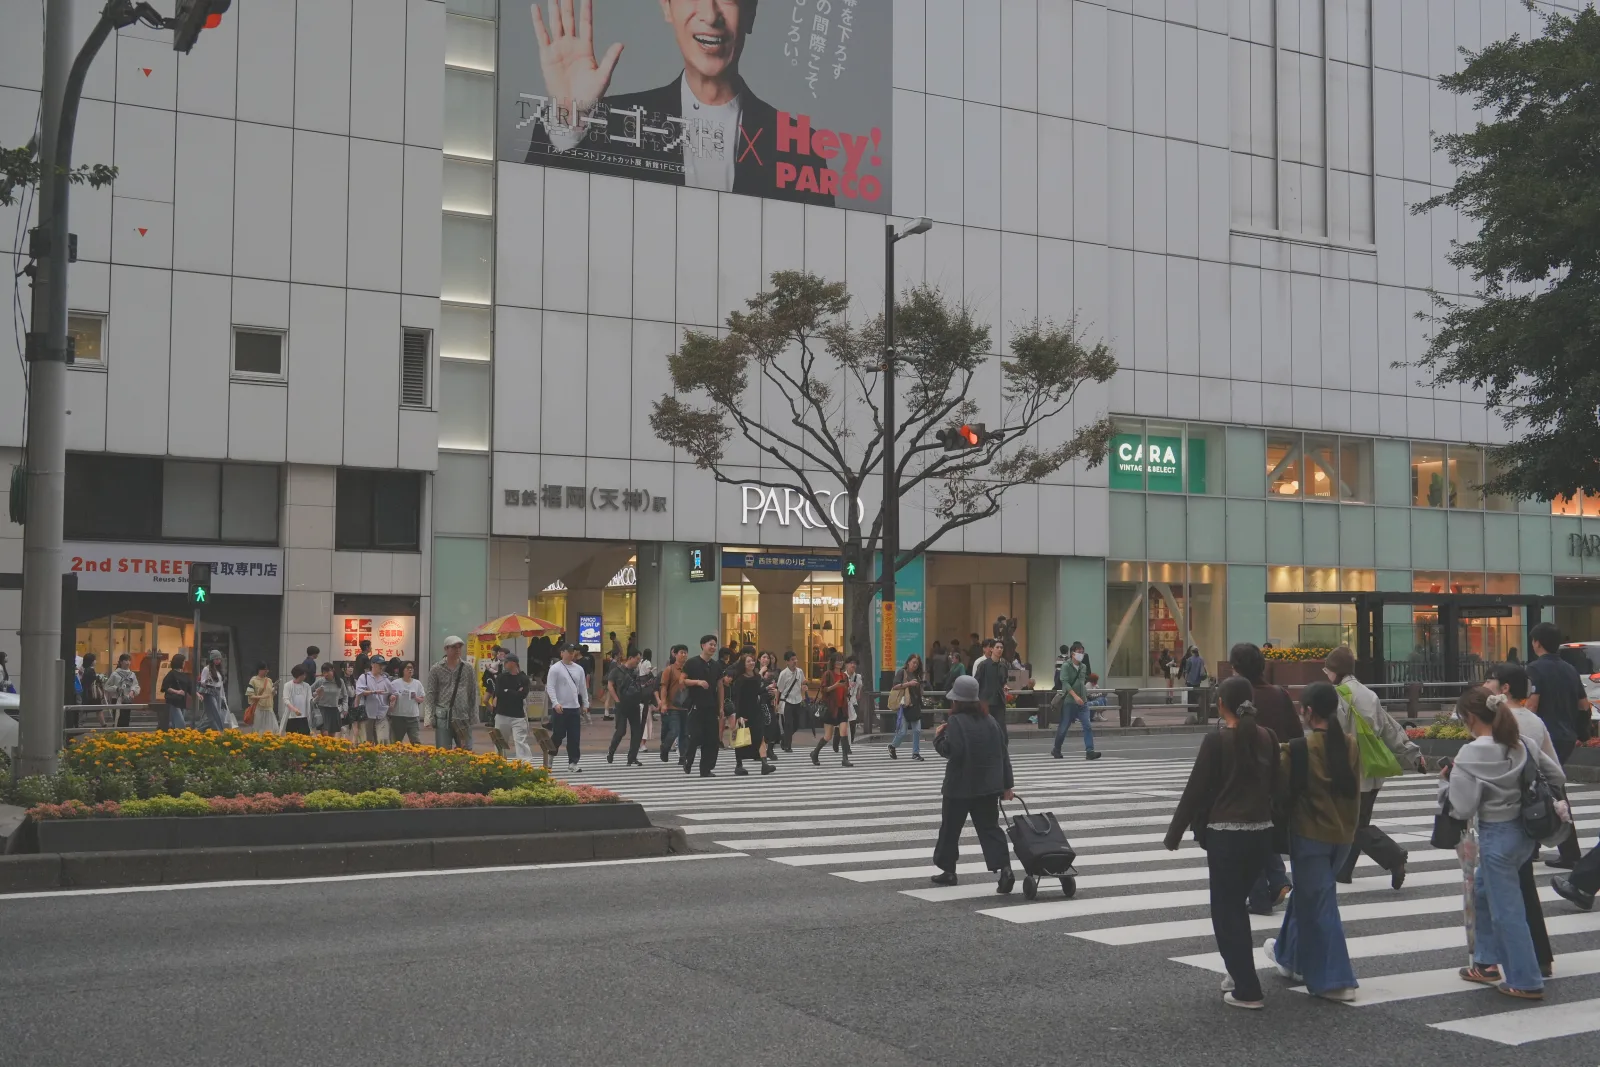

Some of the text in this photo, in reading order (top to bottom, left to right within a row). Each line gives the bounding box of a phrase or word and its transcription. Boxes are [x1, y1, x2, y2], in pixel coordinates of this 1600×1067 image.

[776, 110, 882, 174] Hey!
[776, 161, 882, 202] PARCO
[1118, 442, 1176, 464] CARA
[1119, 463, 1143, 472] VINTAG
[1152, 465, 1176, 474] SELECT
[740, 485, 865, 530] PARCO
[70, 556, 112, 573] 2nd
[152, 575, 176, 583] Reuse
